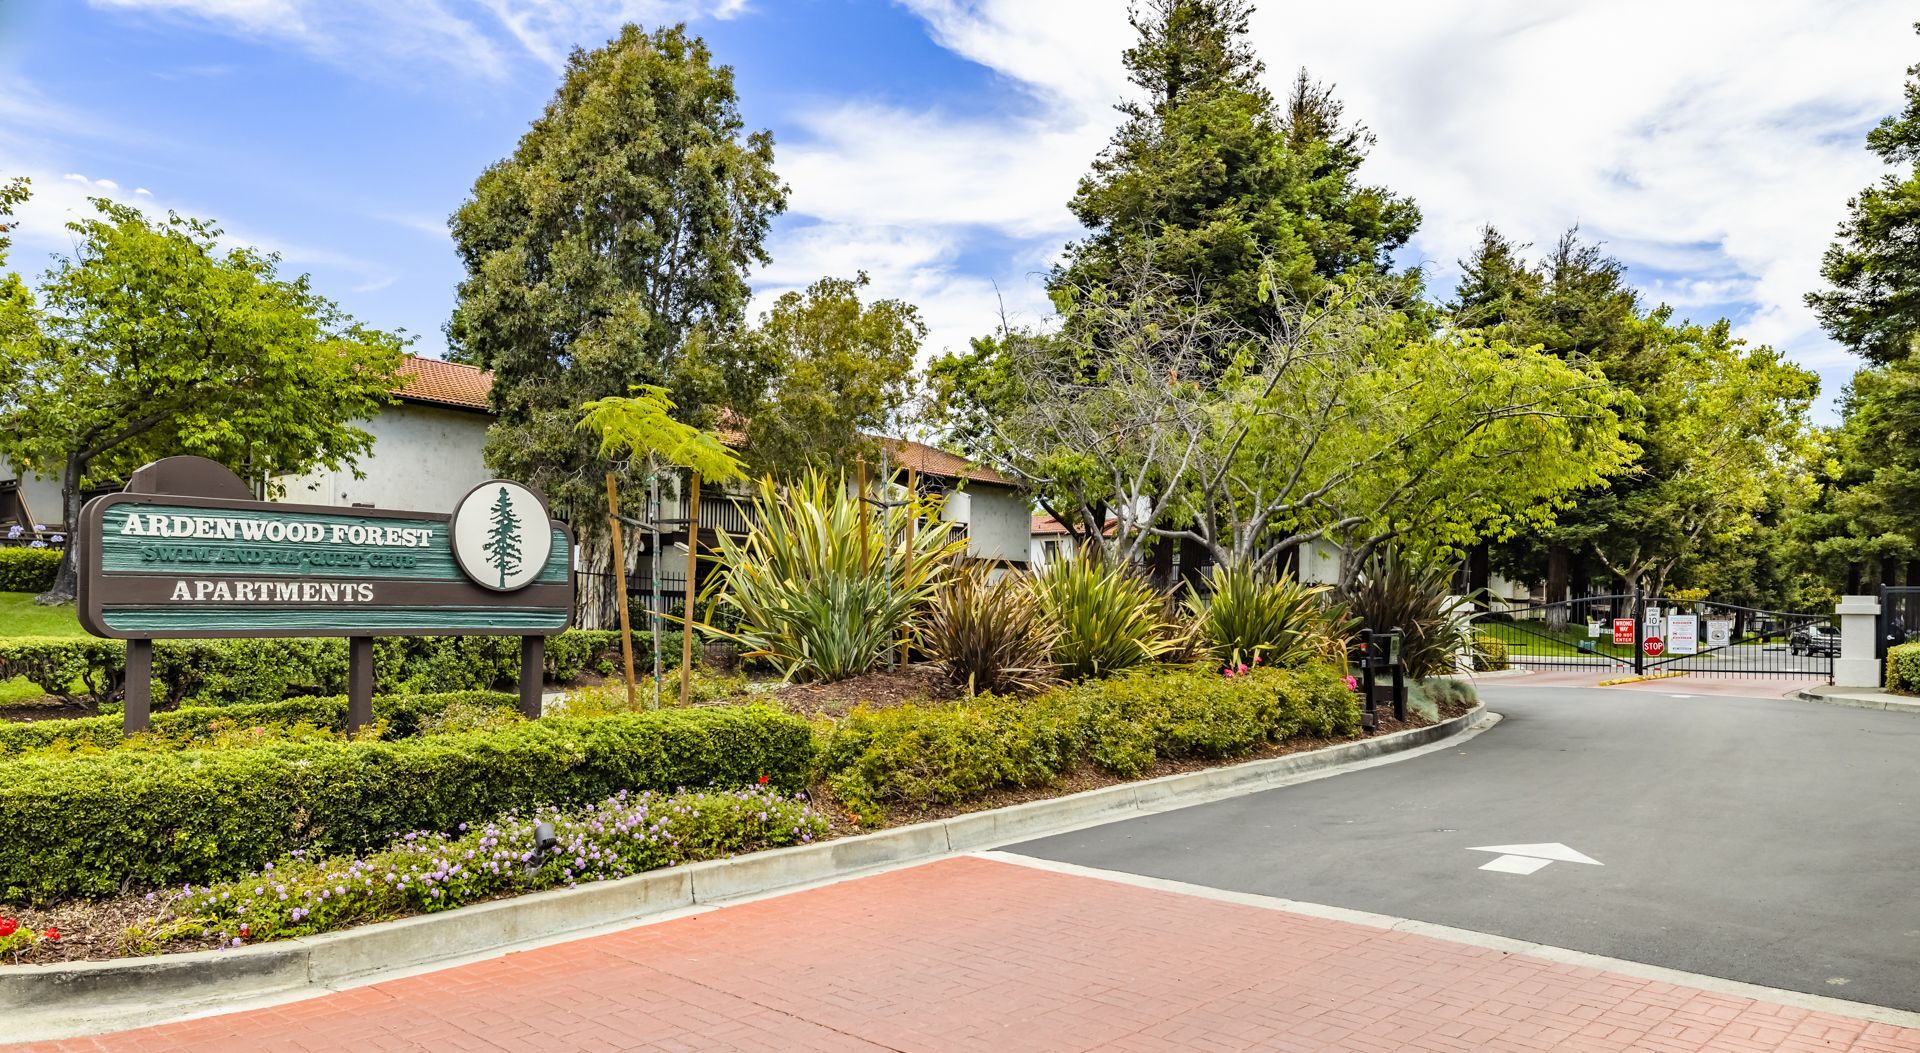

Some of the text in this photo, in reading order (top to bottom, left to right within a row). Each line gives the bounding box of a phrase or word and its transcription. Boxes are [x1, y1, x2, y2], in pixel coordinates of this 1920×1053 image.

[121, 513, 433, 547] ARDENWOOD FOREST
[142, 546, 210, 563] SWIM
[215, 547, 264, 565] AND
[367, 553, 417, 568] CLUB
[170, 580, 374, 602] APARTMENTS
[1648, 617, 1658, 625] 10
[1644, 642, 1663, 650] STOP
